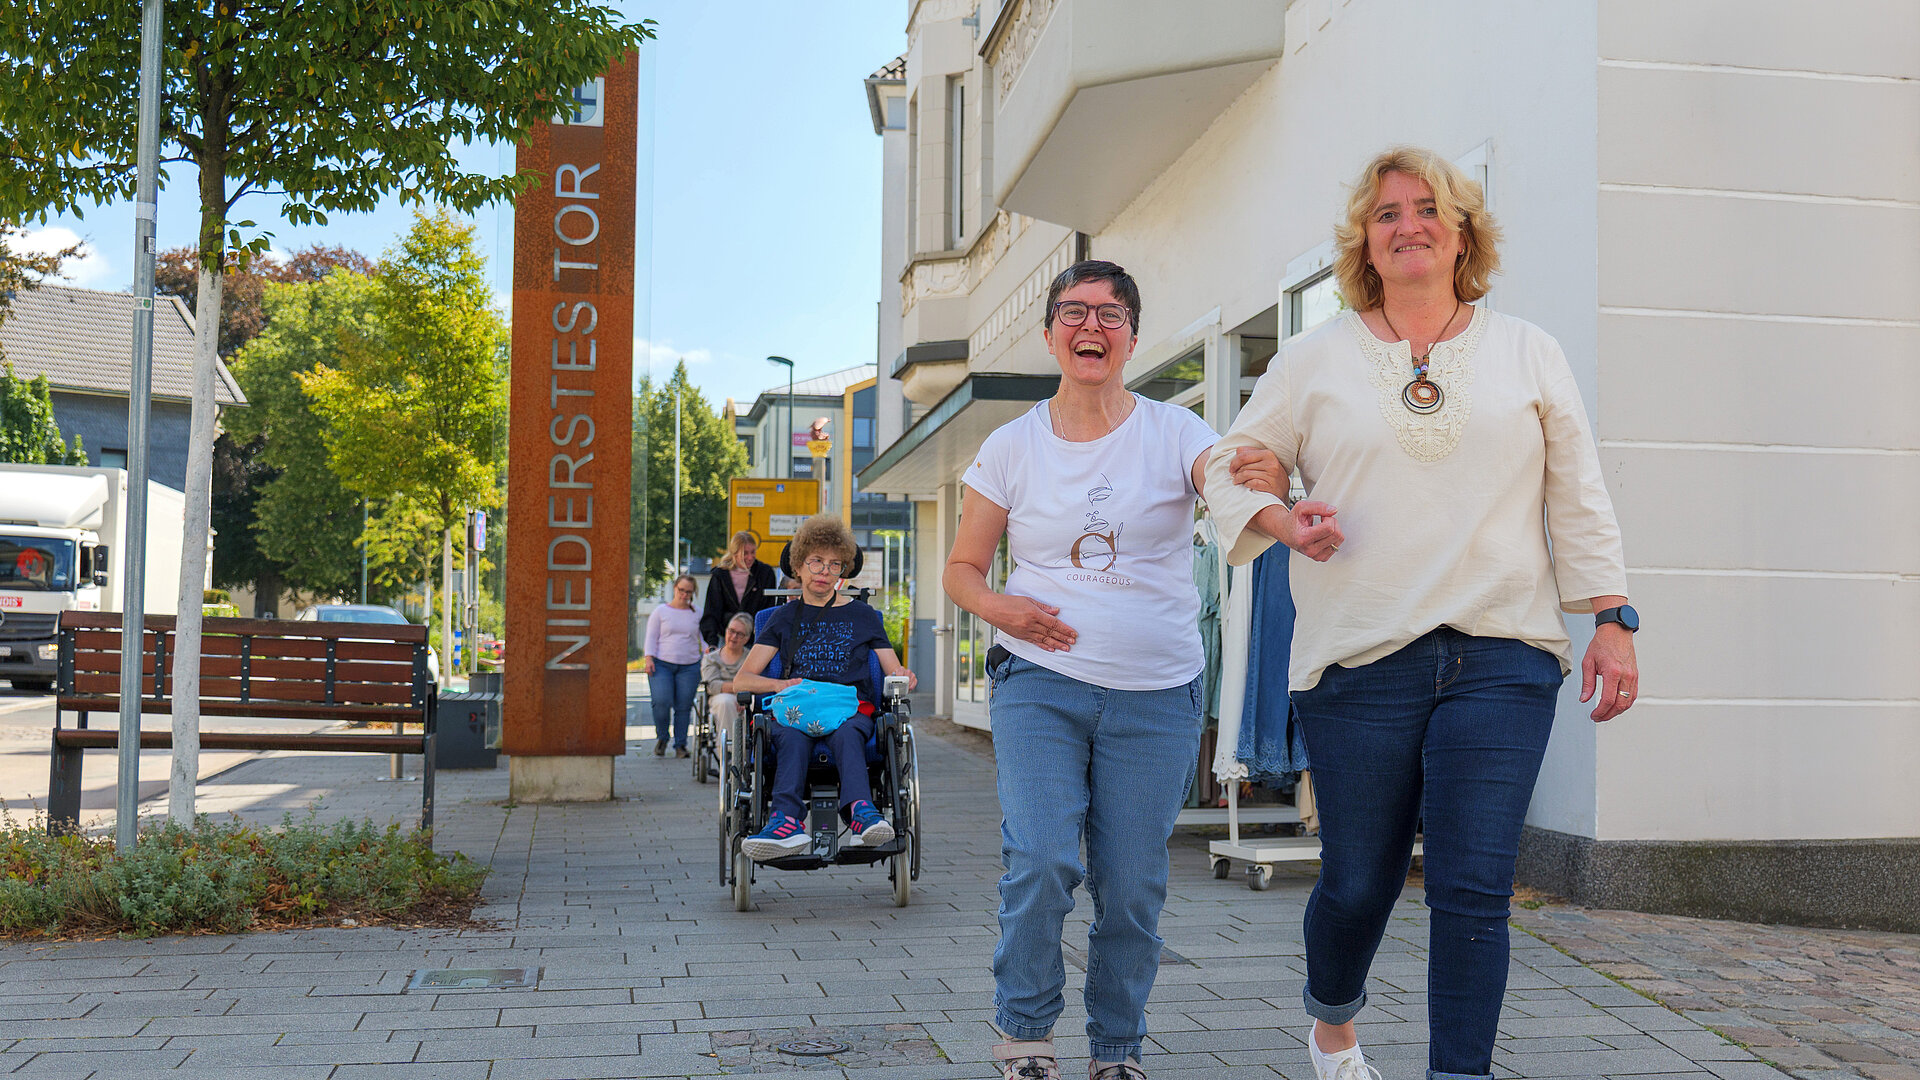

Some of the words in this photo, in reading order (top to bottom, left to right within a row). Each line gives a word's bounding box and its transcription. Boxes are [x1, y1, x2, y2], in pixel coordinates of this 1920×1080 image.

[553, 162, 601, 282] TOR
[544, 301, 598, 670] NIEDERSTES
[1066, 573, 1132, 586] COURAGEOUS
